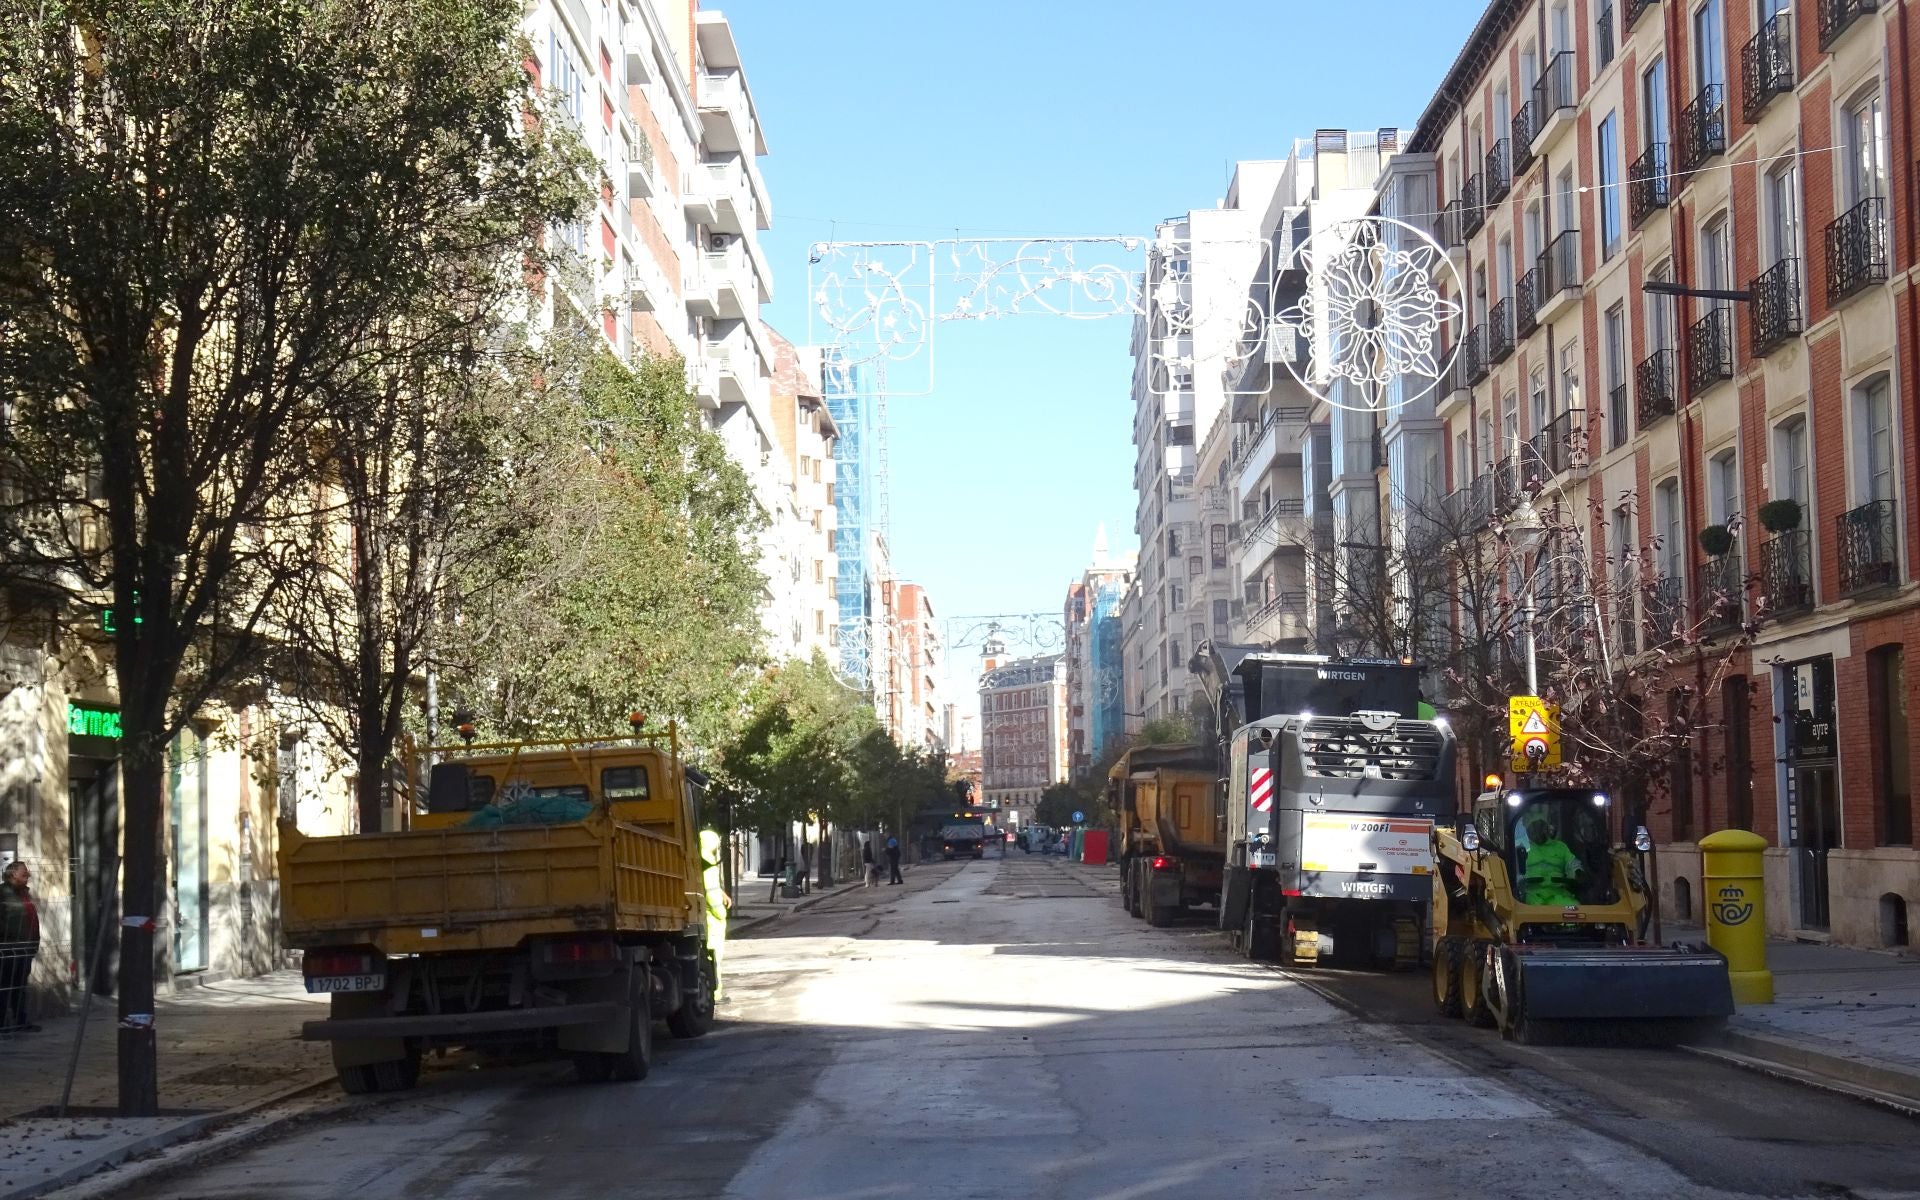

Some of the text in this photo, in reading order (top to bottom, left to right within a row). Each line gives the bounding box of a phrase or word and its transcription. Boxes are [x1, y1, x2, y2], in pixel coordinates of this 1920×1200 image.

[1317, 669, 1366, 681] WIRTGEN
[66, 703, 123, 738] farmac
[1341, 881, 1394, 894] WIRTGEN
[319, 976, 380, 990] 1702 BPJ
